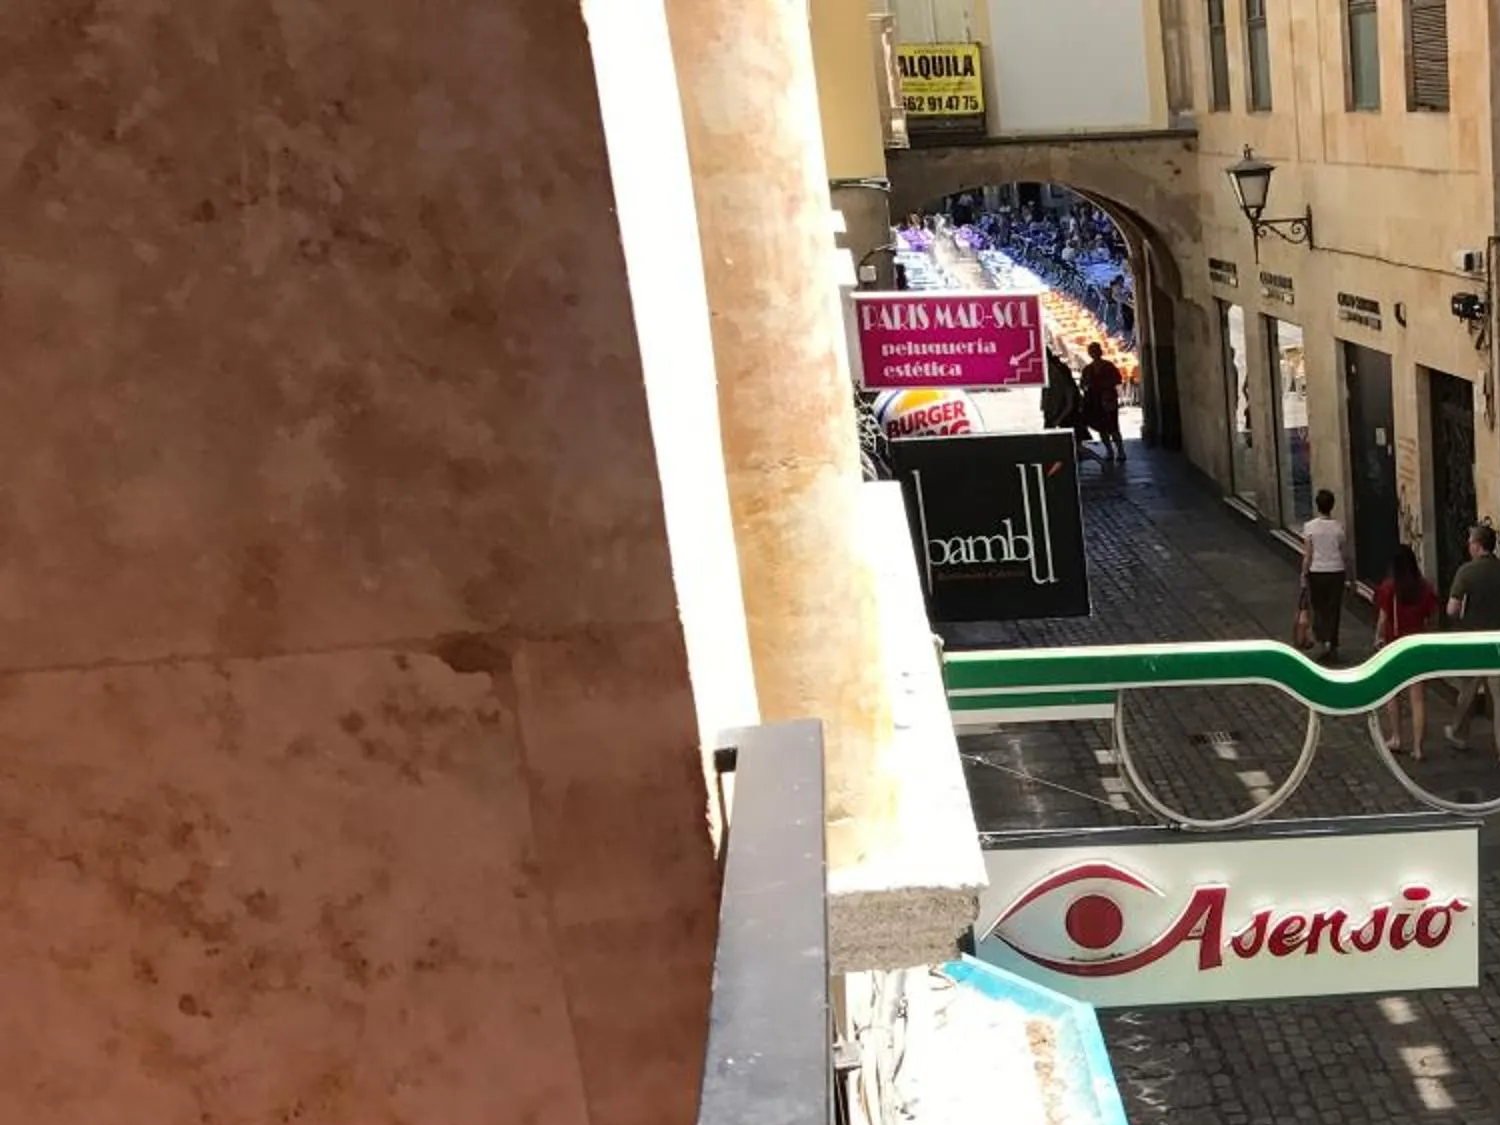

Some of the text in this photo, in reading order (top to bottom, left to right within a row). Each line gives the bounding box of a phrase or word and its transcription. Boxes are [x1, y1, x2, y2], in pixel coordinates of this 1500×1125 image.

[927, 96, 943, 111] 91
[962, 96, 979, 110] 75
[861, 304, 931, 331] PARIS
[883, 361, 962, 378] estética
[886, 400, 966, 438] BURGER
[1155, 883, 1471, 971] Asensio
